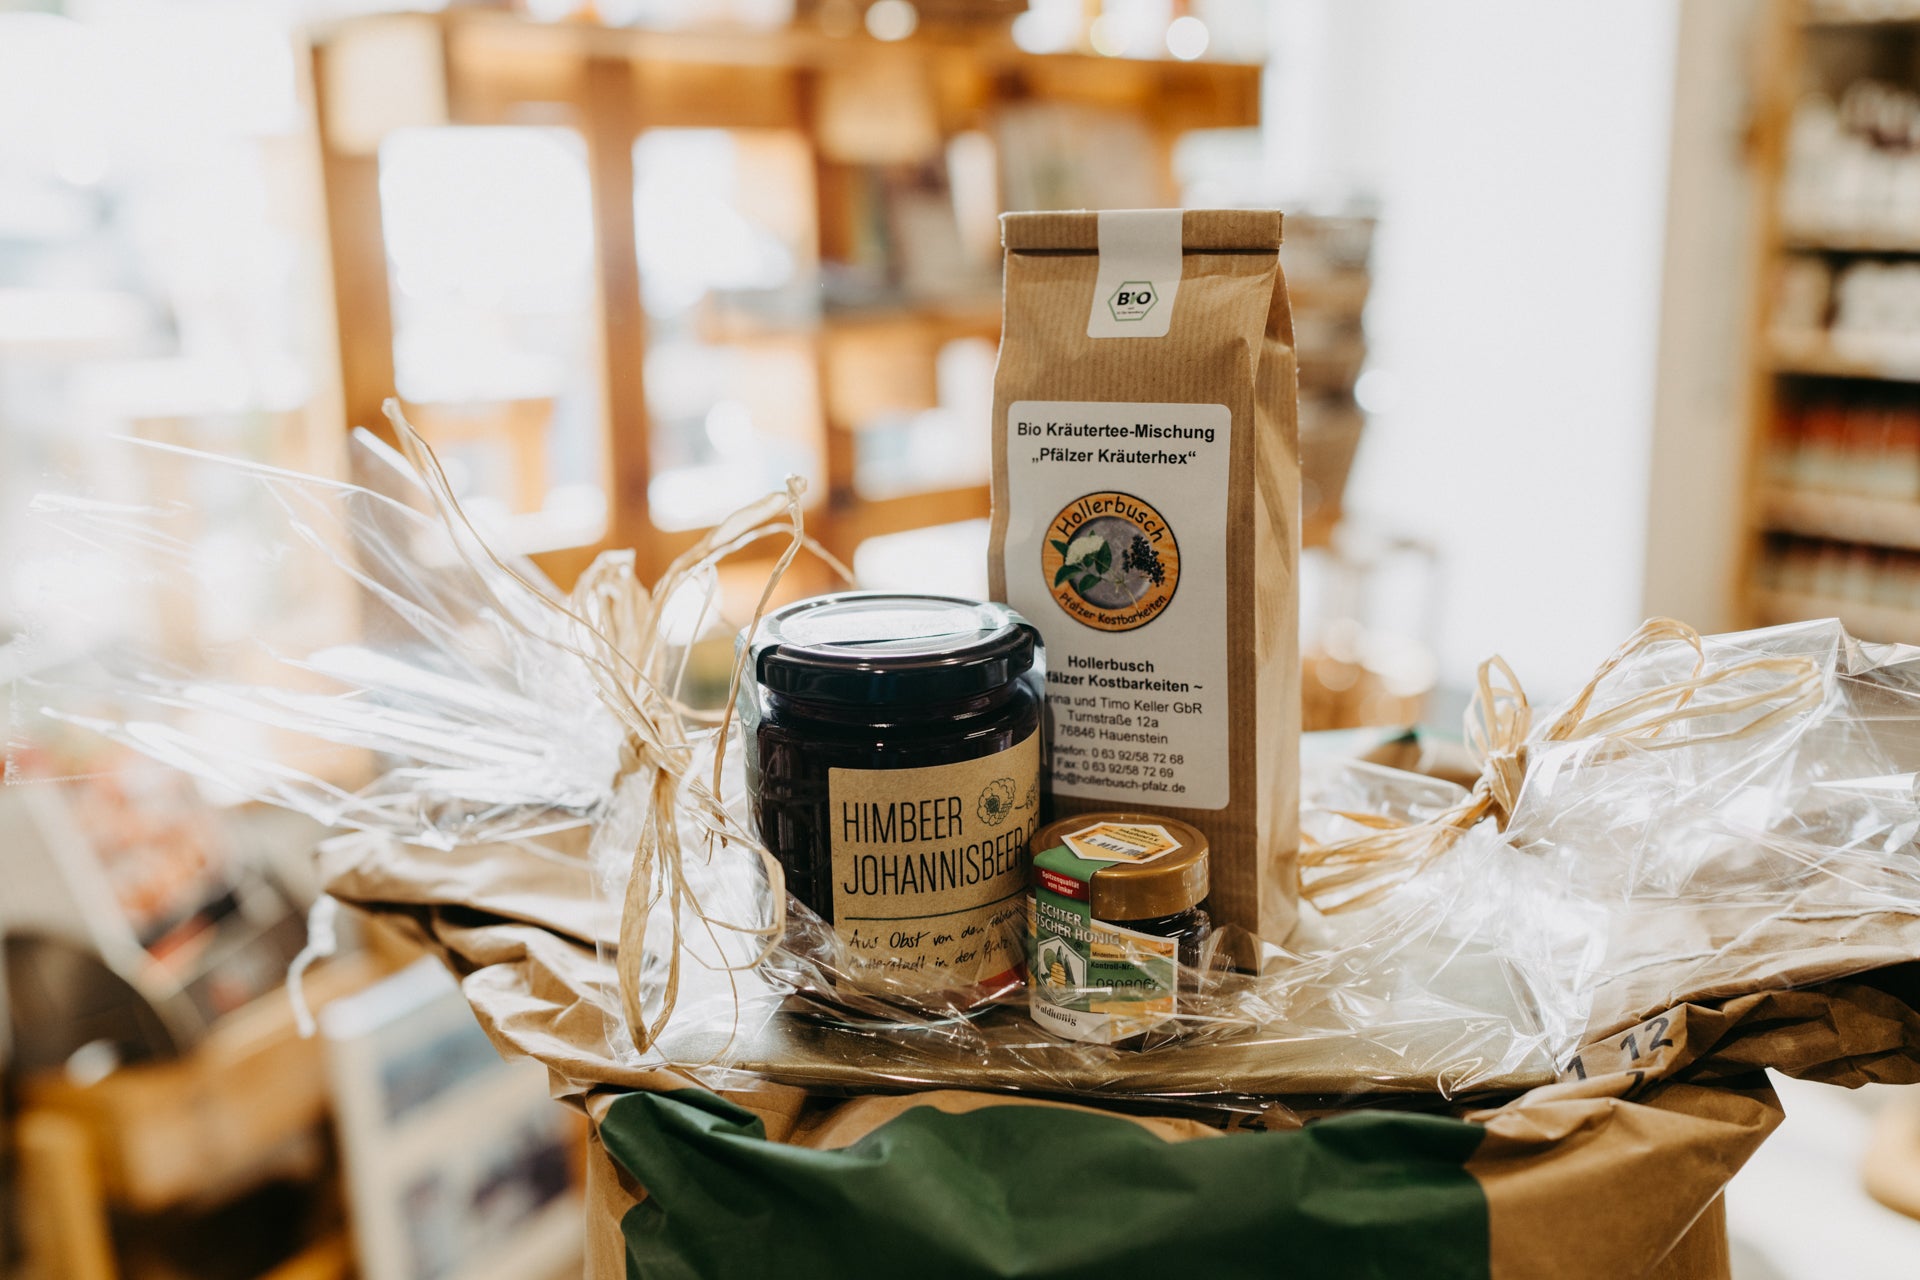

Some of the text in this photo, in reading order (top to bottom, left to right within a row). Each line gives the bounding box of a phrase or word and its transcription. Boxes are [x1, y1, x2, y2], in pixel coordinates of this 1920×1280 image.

[1018, 422, 1215, 442] Bio Kräutertee-Mischung
[1032, 447, 1197, 464] „Pfälzer Kräuterhex“
[1056, 496, 1166, 544] Hollerbusch
[1098, 594, 1168, 626] Kostbarkeiten
[1068, 655, 1154, 673] Hollerbusch
[1045, 671, 1085, 686] fälzer
[1088, 675, 1189, 692] Kostbarkeiten
[1074, 696, 1096, 708] und
[1100, 697, 1130, 710] Timo
[1134, 700, 1170, 713] Keller
[1173, 702, 1202, 714] GbR
[1066, 710, 1160, 728] Turnstraße 12a
[1059, 724, 1168, 744] 76846 Hauenstein
[1049, 742, 1184, 764] elefon: 0 63 92/58 72 68
[1082, 760, 1089, 770] 0
[1092, 761, 1106, 772] 63
[1108, 763, 1140, 775] 92/58
[1143, 765, 1156, 776] 72
[1159, 767, 1174, 778] 69
[1049, 771, 1186, 794] nfo@hollerbusch-pfalz.de
[843, 796, 962, 844] HIMBEER
[843, 827, 1023, 896] JOHANNISBEER
[1042, 870, 1080, 889] Spitzenqualität
[1041, 902, 1082, 926] ECHTER
[849, 929, 879, 949] Aus
[889, 930, 930, 949] Obst
[933, 934, 954, 946] von
[1076, 929, 1120, 945] HONIG
[936, 957, 948, 967] in
[955, 950, 977, 964] der
[1619, 1017, 1674, 1061] 12
